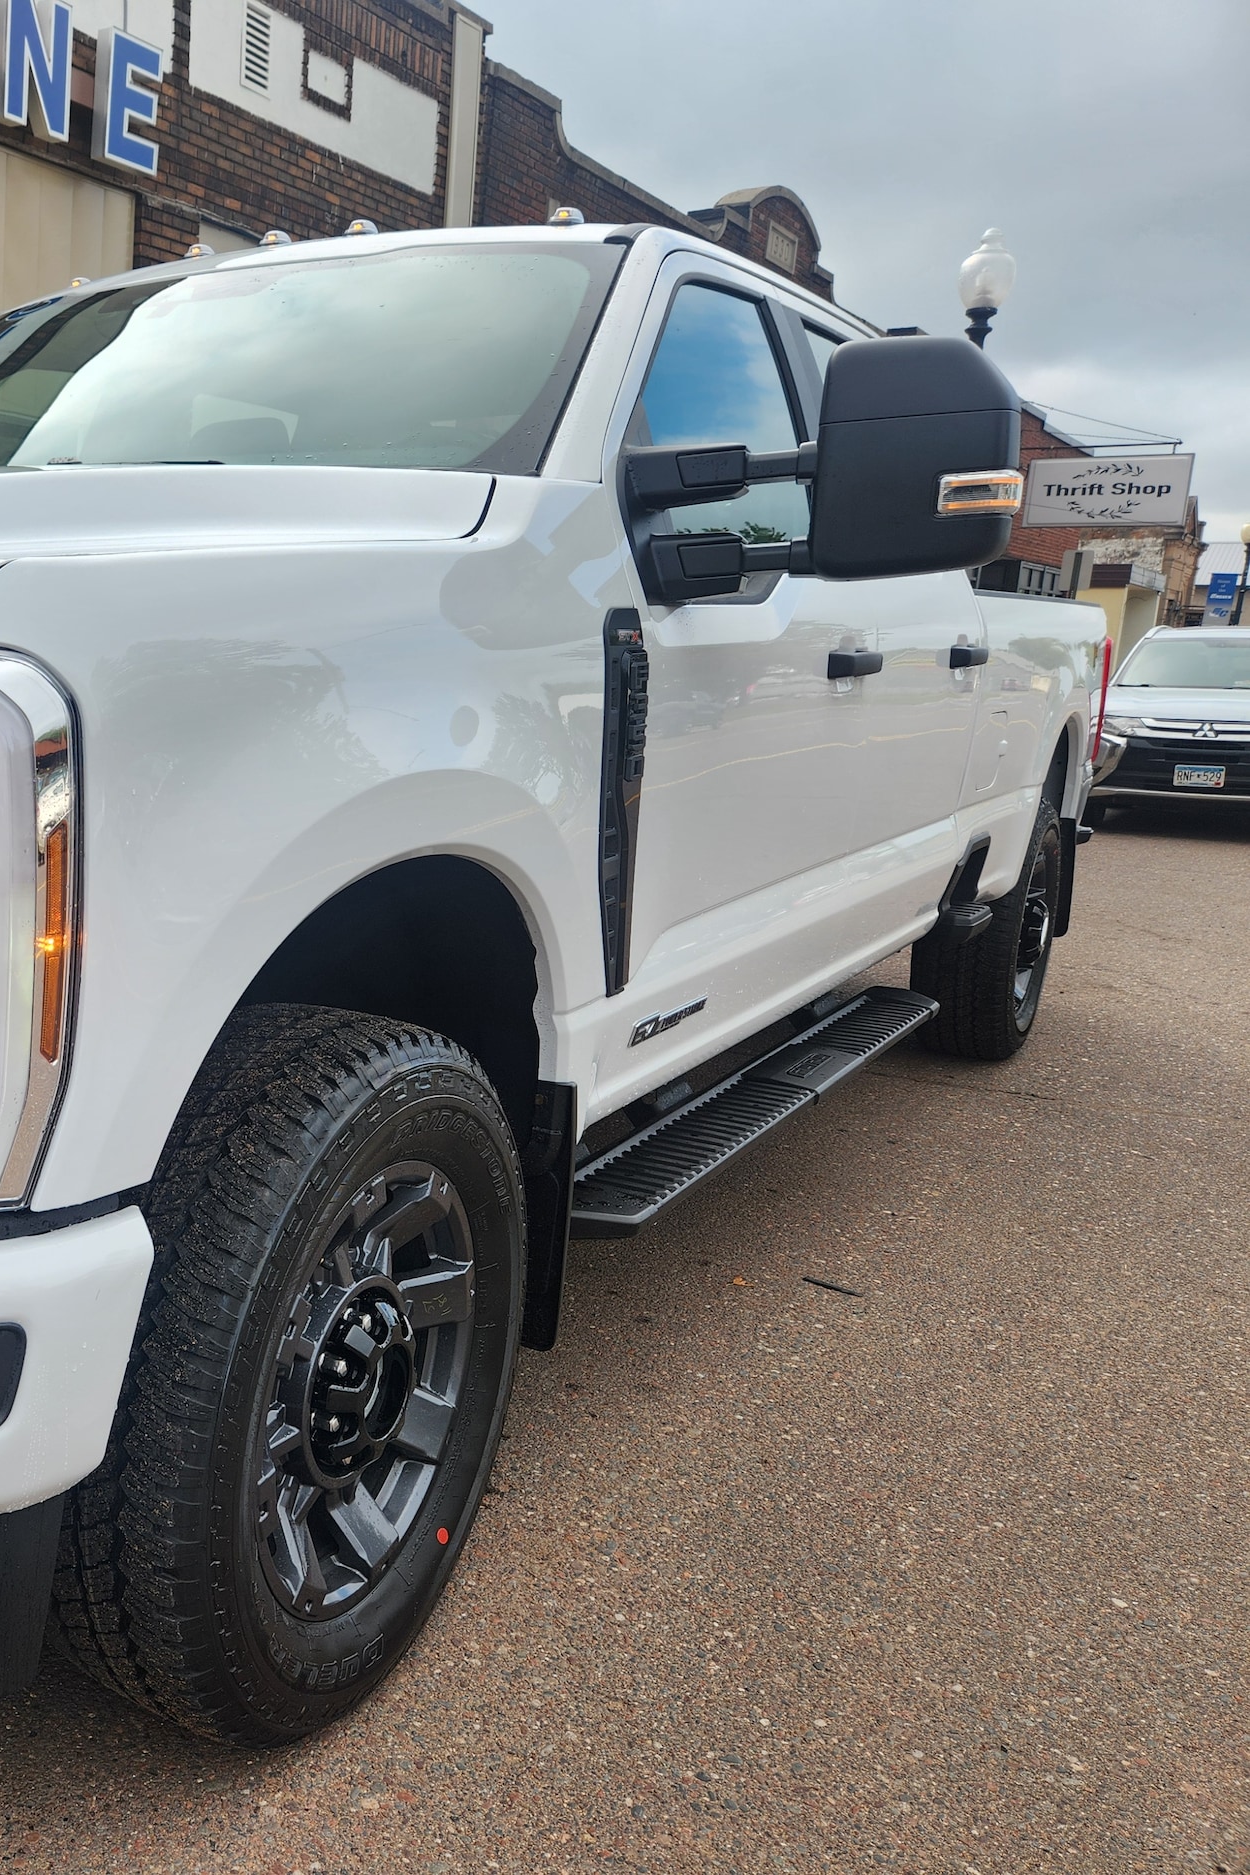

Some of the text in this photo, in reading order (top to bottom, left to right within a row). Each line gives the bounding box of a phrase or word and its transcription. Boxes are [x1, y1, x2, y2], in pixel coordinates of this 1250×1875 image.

[770, 231, 791, 262] 1930
[1042, 482, 1172, 498] Thrift Shop
[618, 630, 640, 642] STX
[1176, 770, 1223, 783] RNF 529
[390, 1108, 513, 1215] BRIDGESTONE
[269, 1632, 385, 1690] DUELER
